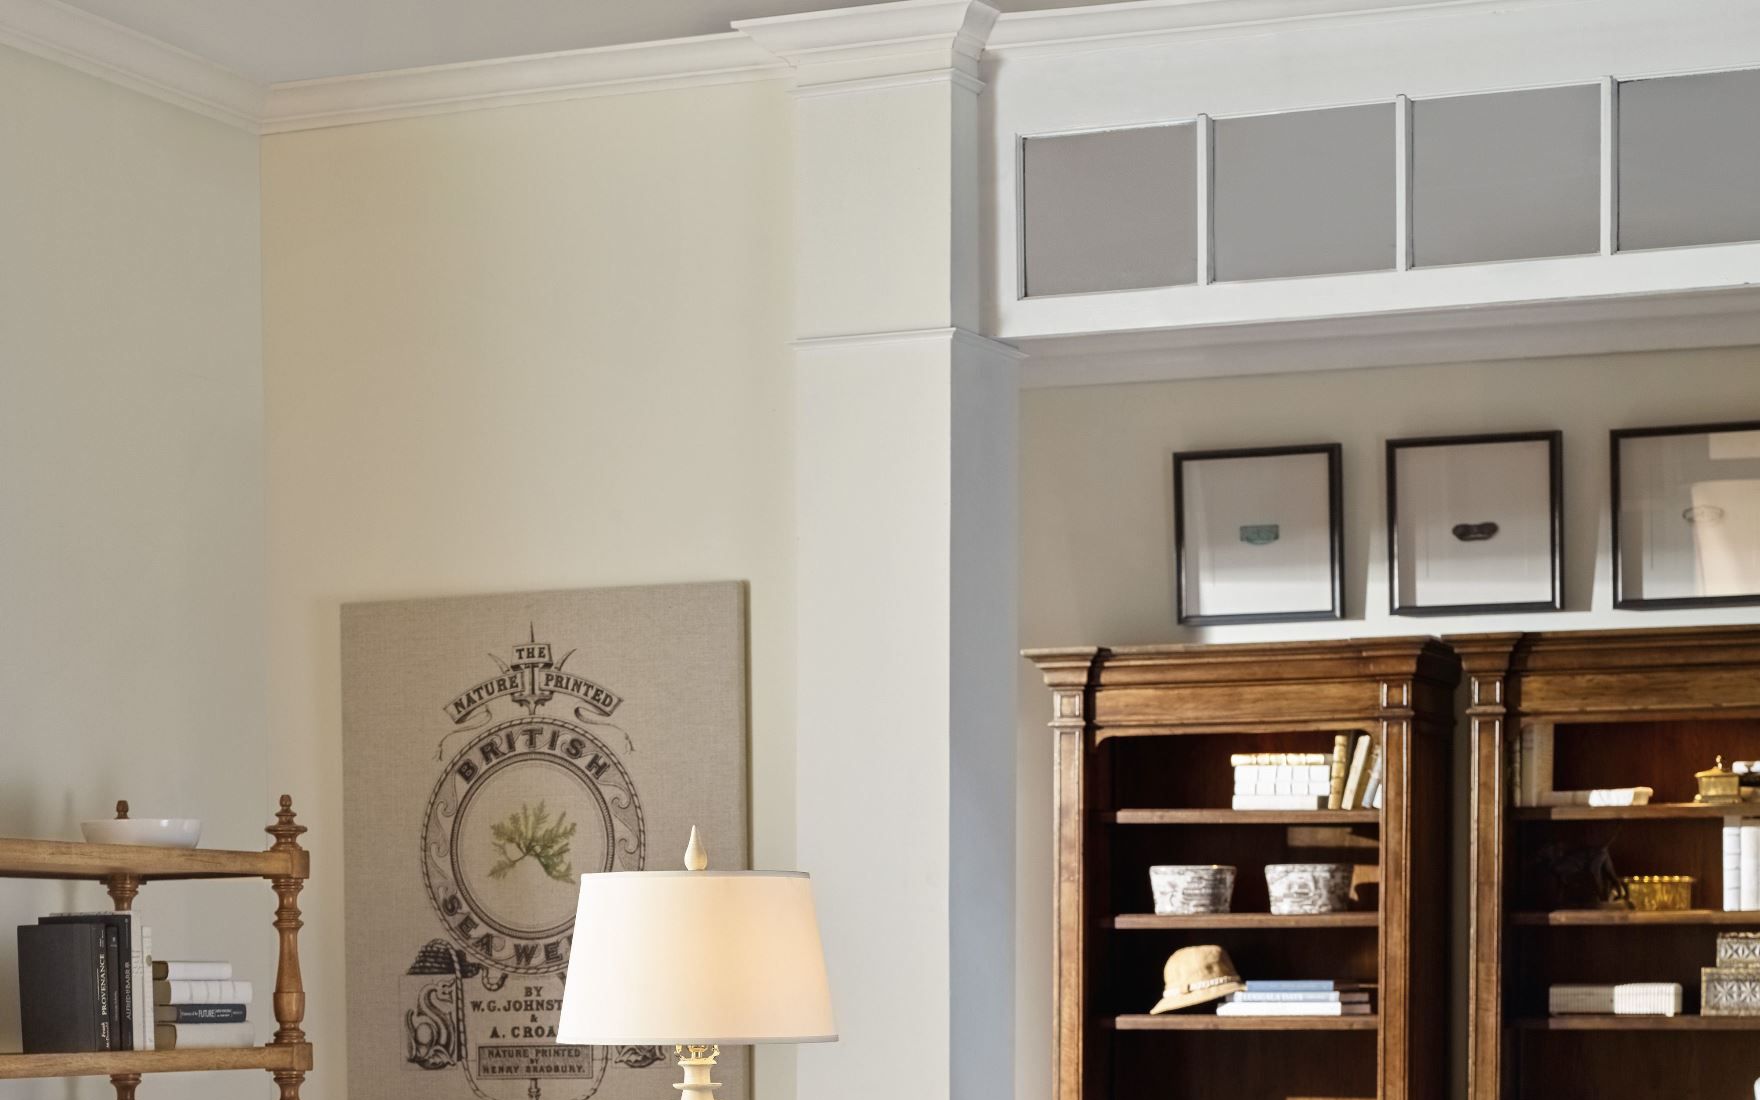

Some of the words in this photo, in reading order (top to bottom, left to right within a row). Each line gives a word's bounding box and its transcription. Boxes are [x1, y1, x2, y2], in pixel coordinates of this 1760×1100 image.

[515, 647, 547, 660] THE
[453, 674, 519, 715] NATURE
[543, 673, 614, 708] PRINTED
[456, 726, 611, 784] BRITISH
[441, 894, 494, 957] SEA
[99, 953, 108, 1016] PROVENANCE
[524, 986, 544, 997] BY
[198, 1009, 215, 1018] FUTURE
[530, 1014, 538, 1023] &
[489, 1026, 506, 1039] A.
[511, 1026, 558, 1038] CROA
[487, 1049, 530, 1058] NATURE
[535, 1048, 581, 1057] PRINTED
[482, 1065, 520, 1074] HENRY
[525, 1064, 585, 1074] BRADBURY.
